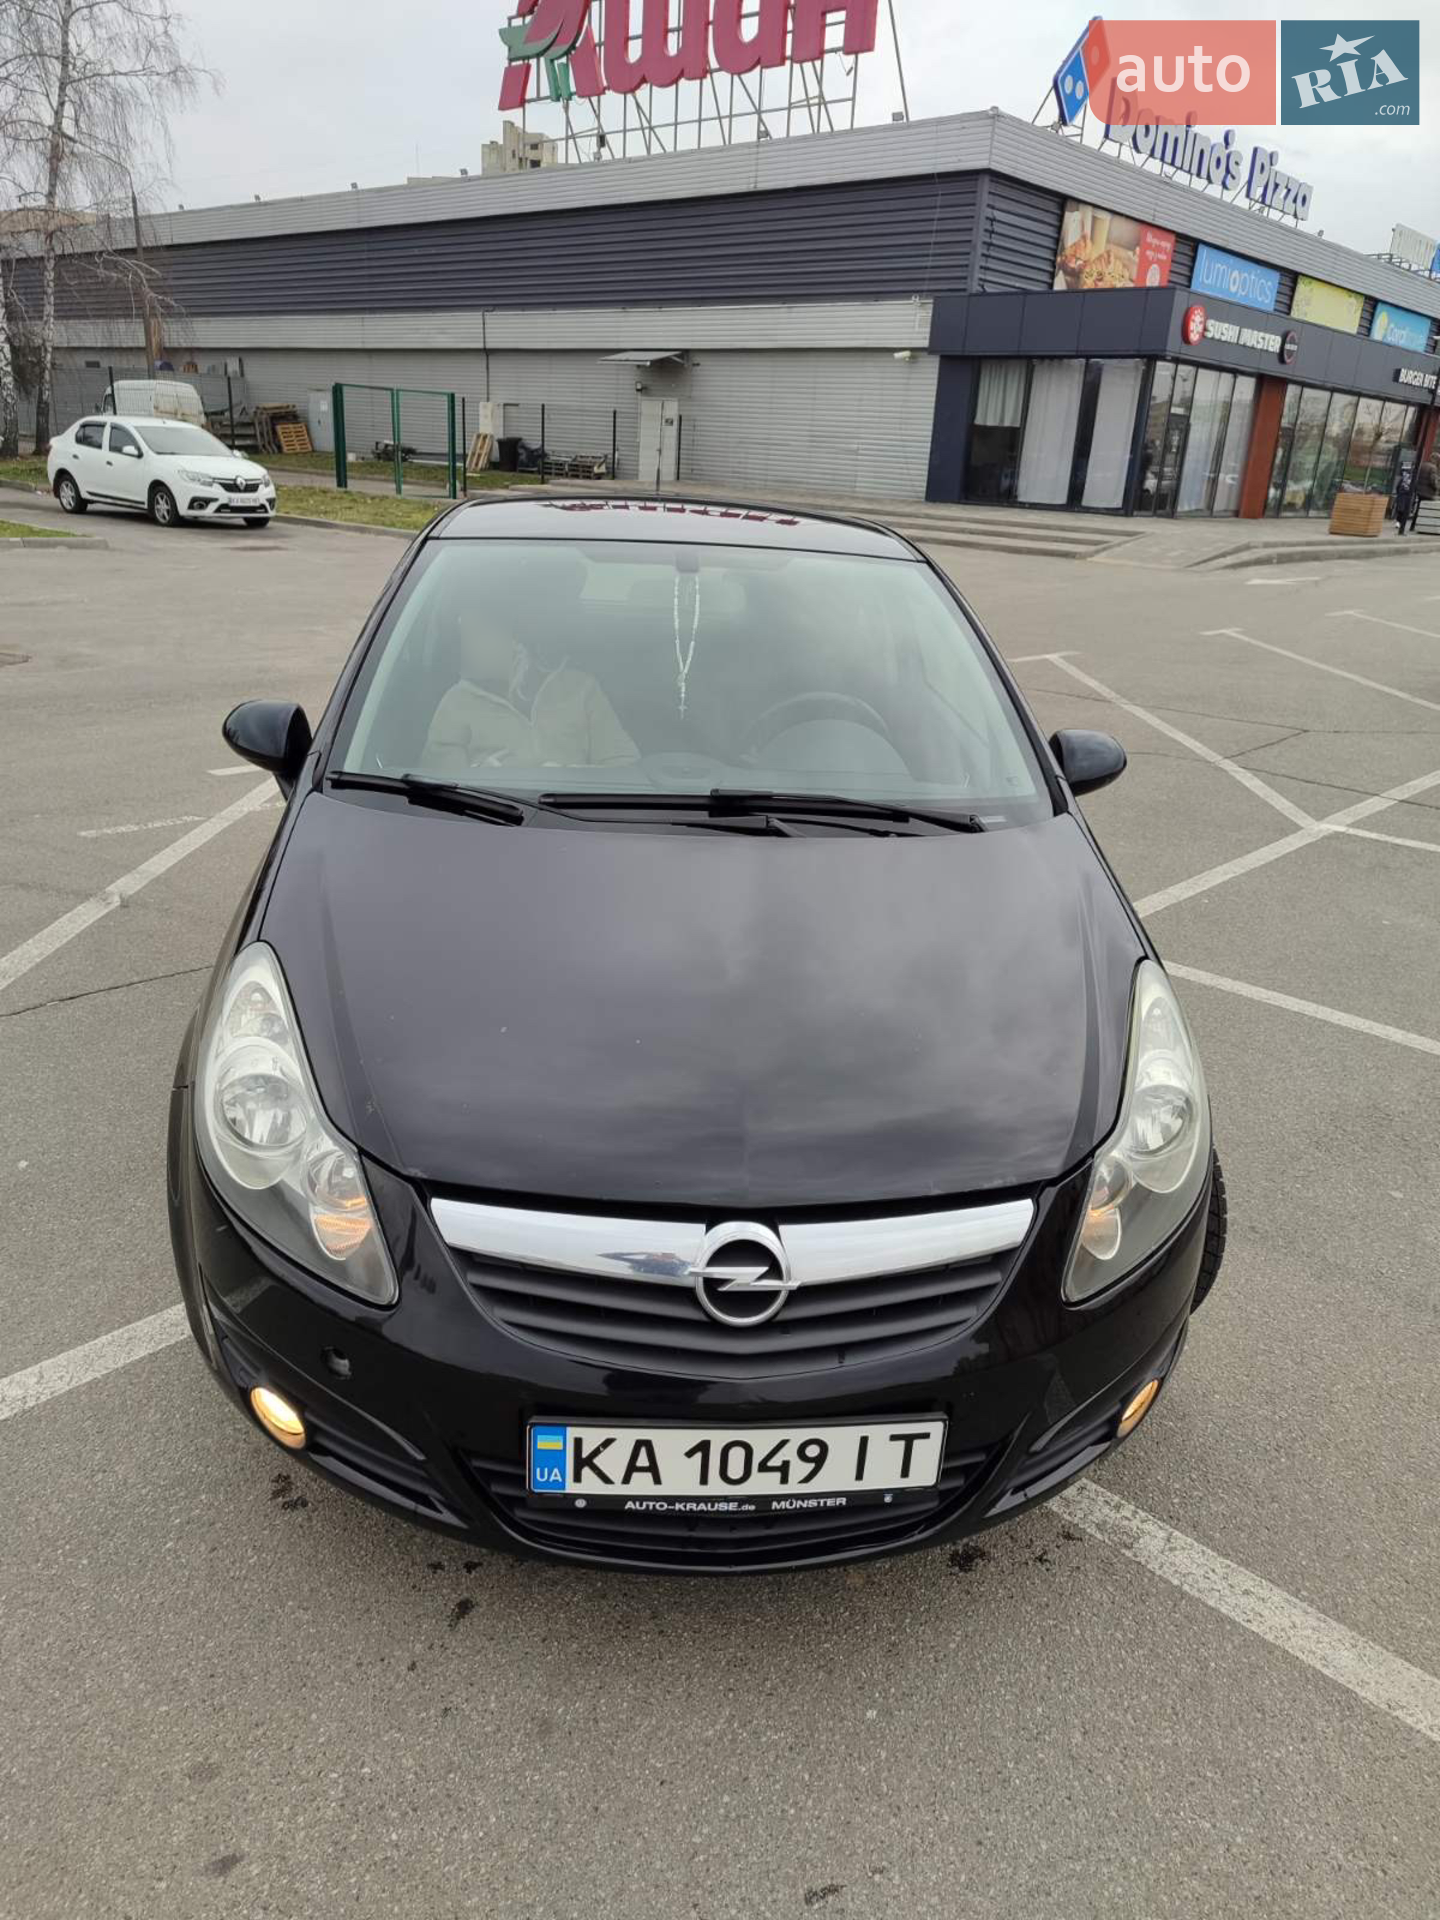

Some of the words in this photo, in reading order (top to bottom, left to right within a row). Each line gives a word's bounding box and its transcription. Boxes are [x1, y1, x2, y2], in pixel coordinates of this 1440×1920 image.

[1103, 76, 1243, 191] Domino's
[1245, 146, 1314, 221] Pizza
[1204, 318, 1240, 345] SUSHI
[1238, 327, 1282, 353] MASTER
[536, 1467, 563, 1483] UA
[572, 1437, 663, 1486] KA
[683, 1439, 830, 1486] 1049
[624, 1500, 757, 1512] AUTO-KRAUSE.de
[771, 1497, 848, 1511] MÜNSTER
